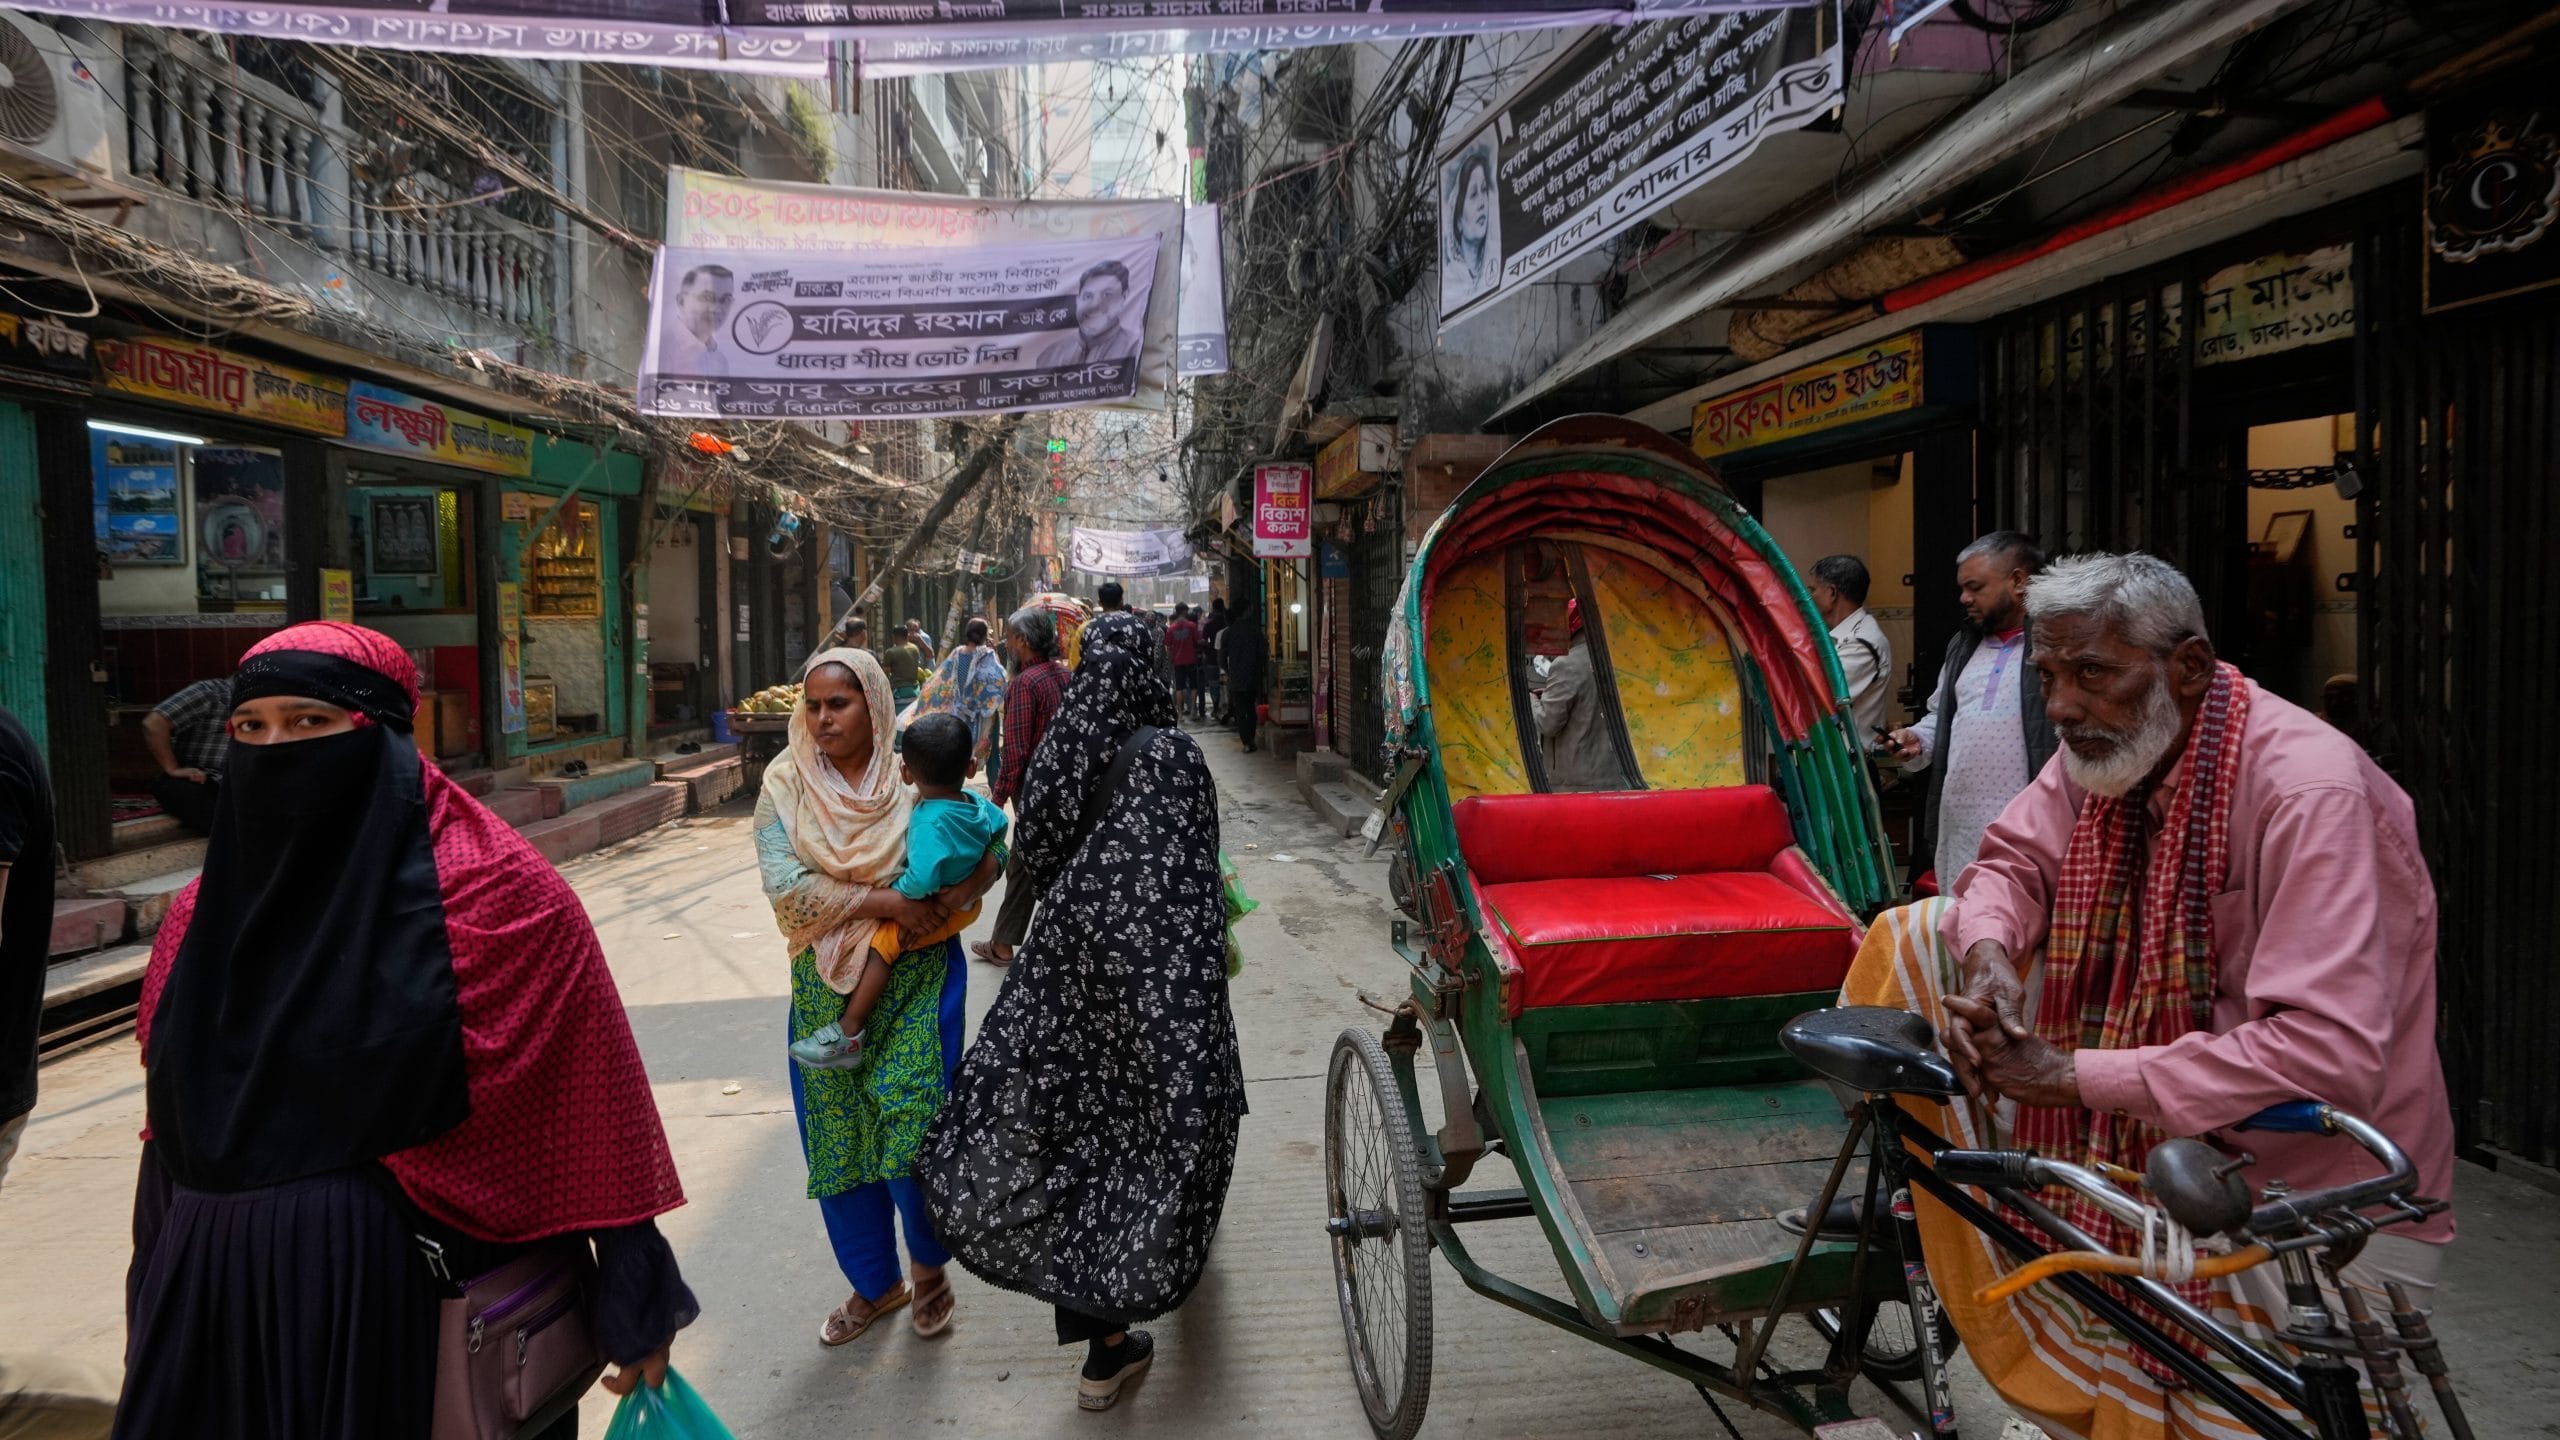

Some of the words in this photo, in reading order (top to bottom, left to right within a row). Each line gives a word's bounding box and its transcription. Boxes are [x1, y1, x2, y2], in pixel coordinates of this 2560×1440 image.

[766, 2, 849, 22] বাংলাদেশ
[1519, 104, 1551, 144] বিএনপি
[1616, 47, 1626, 63] ও
[1546, 139, 1580, 171] করেছেন
[1649, 66, 1673, 95] ওয়া
[1674, 47, 1697, 78] ইন্না
[1501, 154, 1529, 180] বেগম
[1533, 112, 1572, 154] খালেদা
[1575, 86, 1605, 125] জিয়া
[1521, 184, 1546, 214] আমরা
[1592, 124, 1643, 164] মাগফিরাত
[1644, 92, 1675, 127] কামনা
[1676, 66, 1709, 102] করছি
[1709, 47, 1741, 79] এবং
[1542, 199, 1566, 227] নিকট
[1651, 118, 1675, 148] জন্য
[1678, 91, 1712, 133] দোয়া
[1713, 69, 1749, 109] চাচ্ছি
[1508, 205, 1603, 279] বাংলাদেশ
[1612, 137, 1715, 215] পোদ্দার
[798, 283, 841, 297] ঢাকা-৭
[898, 284, 951, 299] বিএনপি
[22, 314, 90, 361] হাউজ
[800, 308, 905, 338] হামিদুর
[912, 308, 1009, 333] রহমান
[1048, 307, 1070, 323] কে
[2250, 307, 2356, 346] ঢাকা-১১০০
[775, 352, 846, 370] ধানের
[853, 347, 911, 370] শীষে
[915, 345, 970, 369] ভোট
[975, 342, 1022, 365] দিন
[657, 378, 732, 397] মোঃ
[746, 380, 829, 402] আবু
[840, 378, 969, 396] তাহের
[1000, 362, 1123, 391] সভাপতি
[1707, 381, 1784, 449] হারুন
[1786, 372, 1838, 414] গোল্ড
[1843, 349, 1912, 399] হাউজ
[356, 395, 448, 451] লক্ষ্মী
[650, 397, 682, 412] ৩৬
[687, 398, 713, 413] নং
[720, 398, 777, 415] ওয়ার্ড
[784, 398, 863, 415] বিএনপি
[976, 394, 1020, 408] থানা
[1260, 502, 1307, 522] বিকাশ
[1272, 490, 1301, 509] বিল
[1266, 521, 1301, 535] করুন
